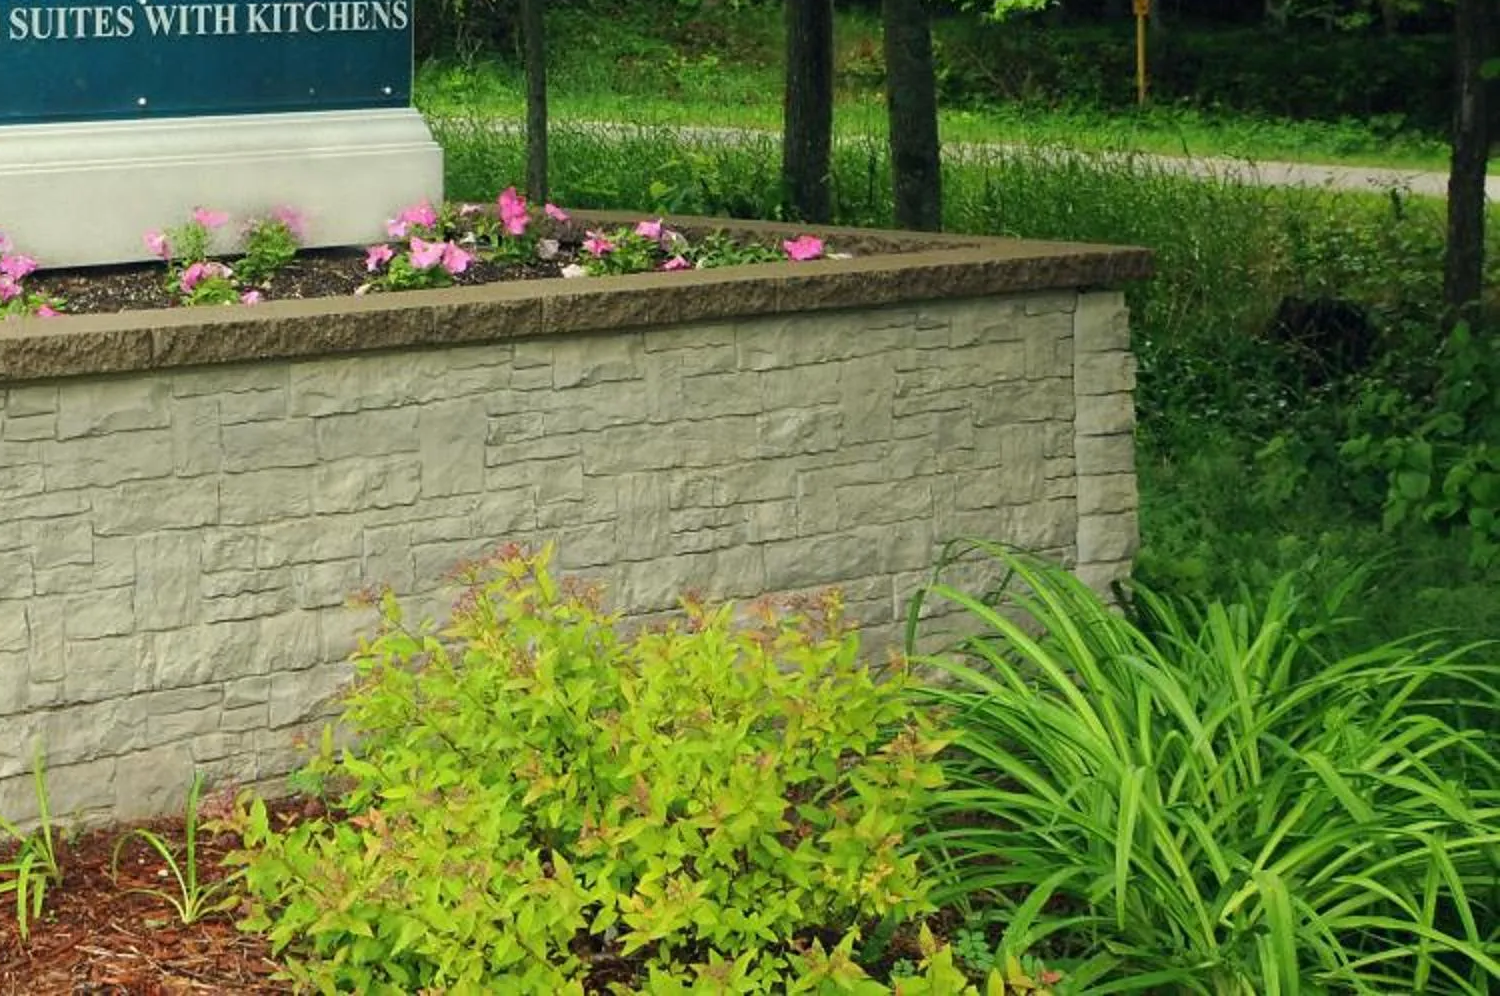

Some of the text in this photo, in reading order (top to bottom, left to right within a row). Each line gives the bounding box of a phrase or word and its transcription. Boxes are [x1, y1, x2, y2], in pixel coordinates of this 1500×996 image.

[9, 5, 134, 42] SUITES
[146, 3, 235, 37] WITH
[247, 0, 408, 35] KITCHENS
